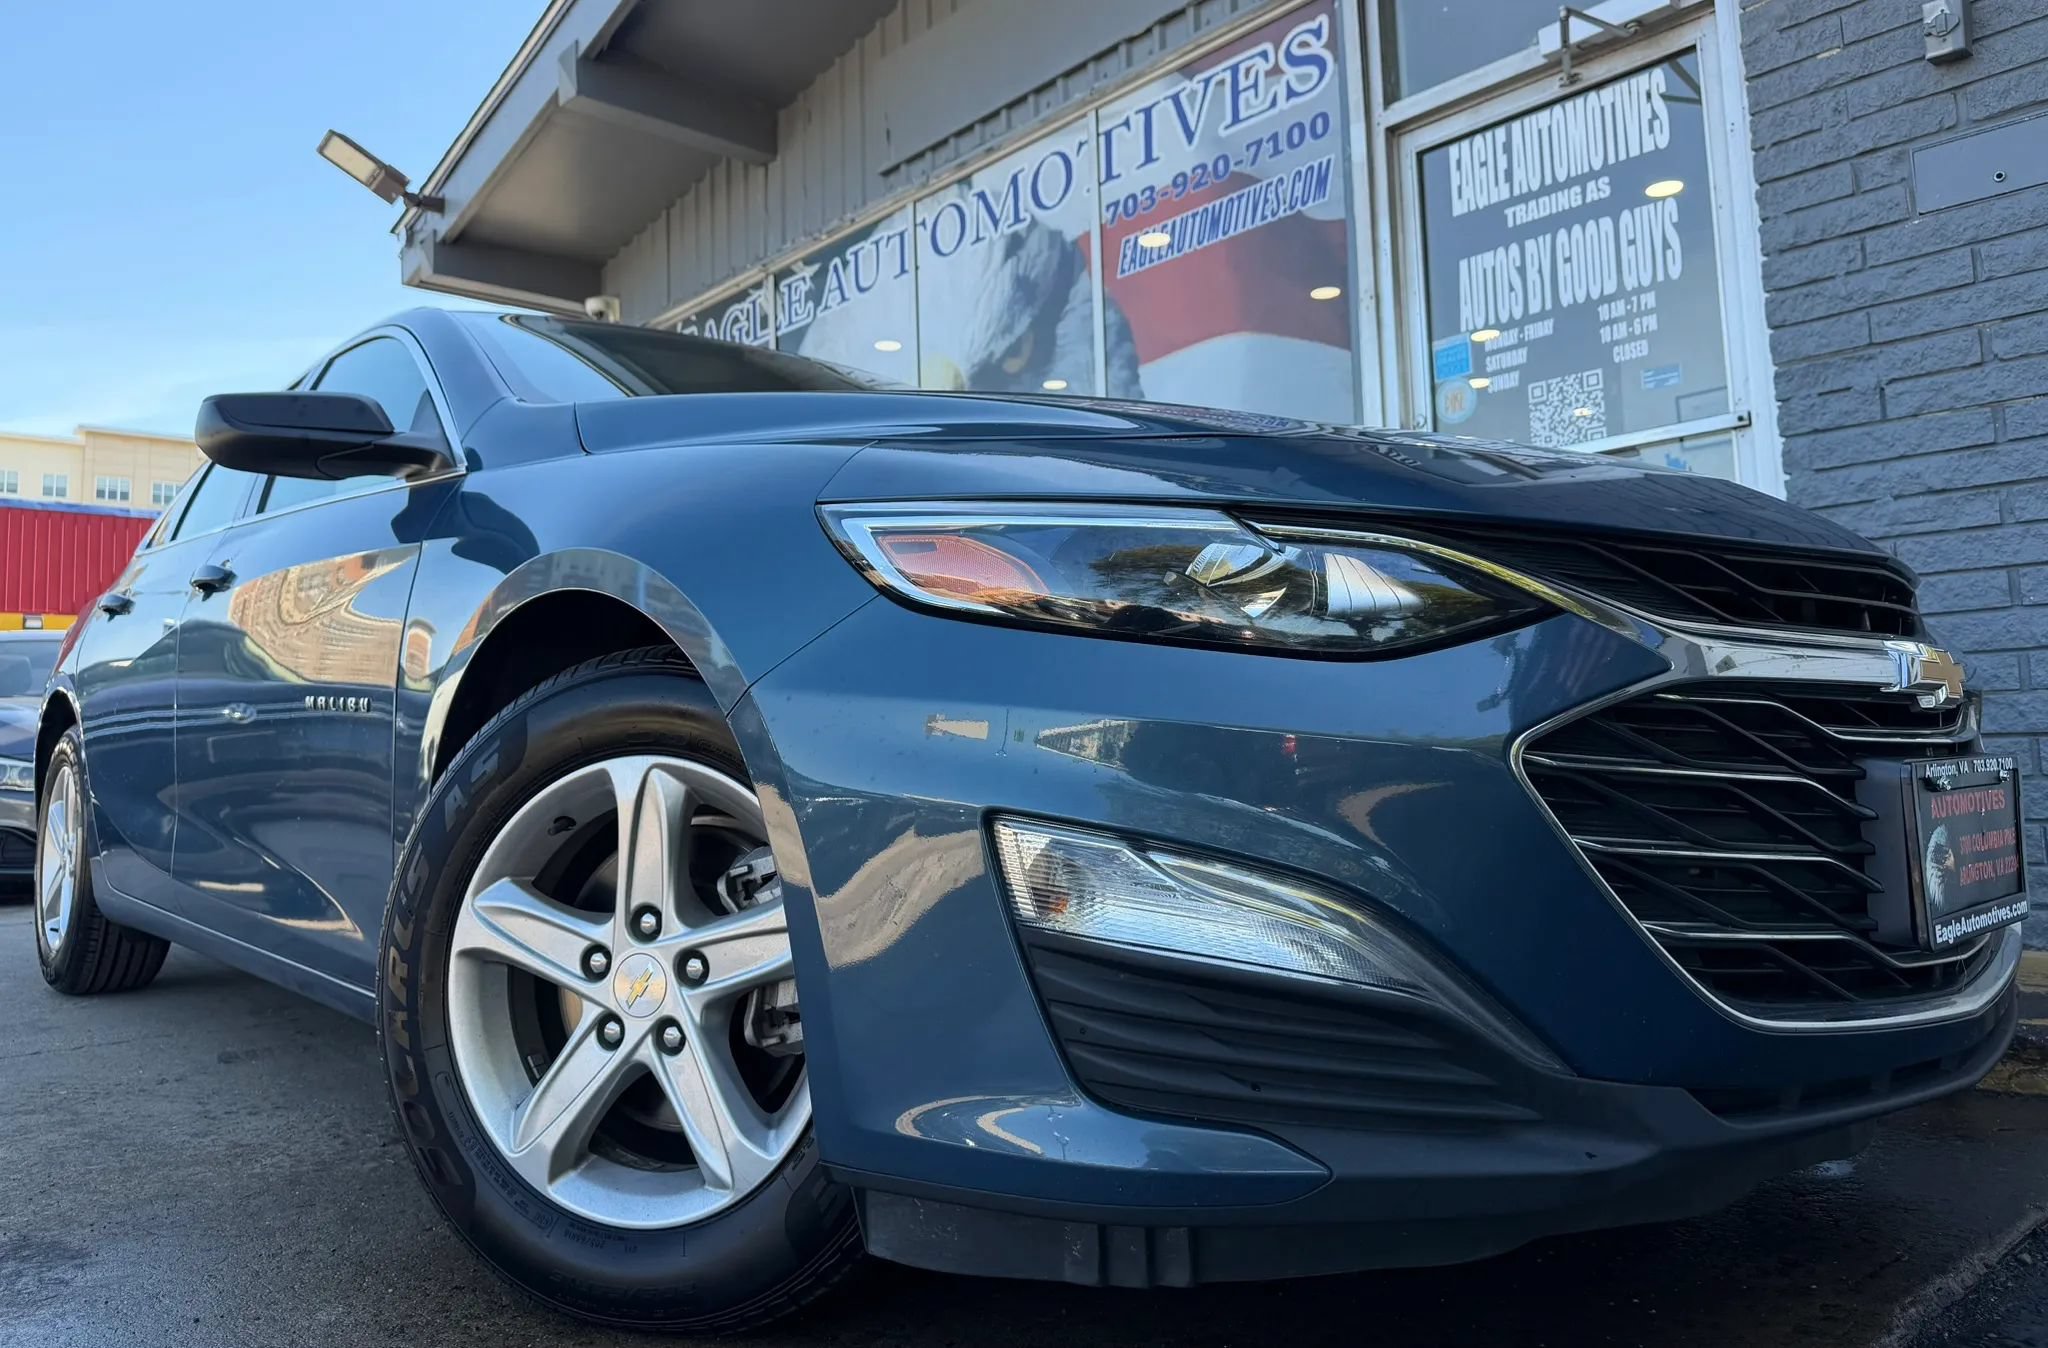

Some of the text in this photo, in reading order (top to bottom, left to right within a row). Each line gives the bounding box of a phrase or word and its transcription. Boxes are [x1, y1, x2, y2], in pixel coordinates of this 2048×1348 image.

[1448, 67, 1672, 217] EAGLE AUTOMOTIVES
[816, 14, 1335, 316] AUTOMOTIVES
[1105, 111, 1331, 228] 703-920-7100
[1117, 153, 1336, 280] EAGLEAUTOMOTIVES.COM
[1504, 176, 1611, 228] TRADING AS
[1459, 197, 1683, 332] AUTOS BY GOOD GUYS
[1597, 303, 1610, 322] 10
[1610, 299, 1626, 319] AM
[1631, 295, 1638, 313] 7
[1640, 290, 1656, 311] PM
[1524, 318, 1554, 342] FRIDAY
[1600, 325, 1611, 344] 10
[1612, 321, 1628, 341] AM
[1642, 313, 1658, 333] PM
[1485, 346, 1528, 372] SATURDAY
[1613, 339, 1649, 363] CLOSED
[1487, 370, 1519, 394] SUNDAY
[305, 695, 371, 712] MALIBU
[1925, 757, 2013, 778] Arlington, VA 703.920.7100
[1931, 789, 2005, 819] AUTOMOTIVES
[1935, 900, 2028, 944] EagleAutomotives.com
